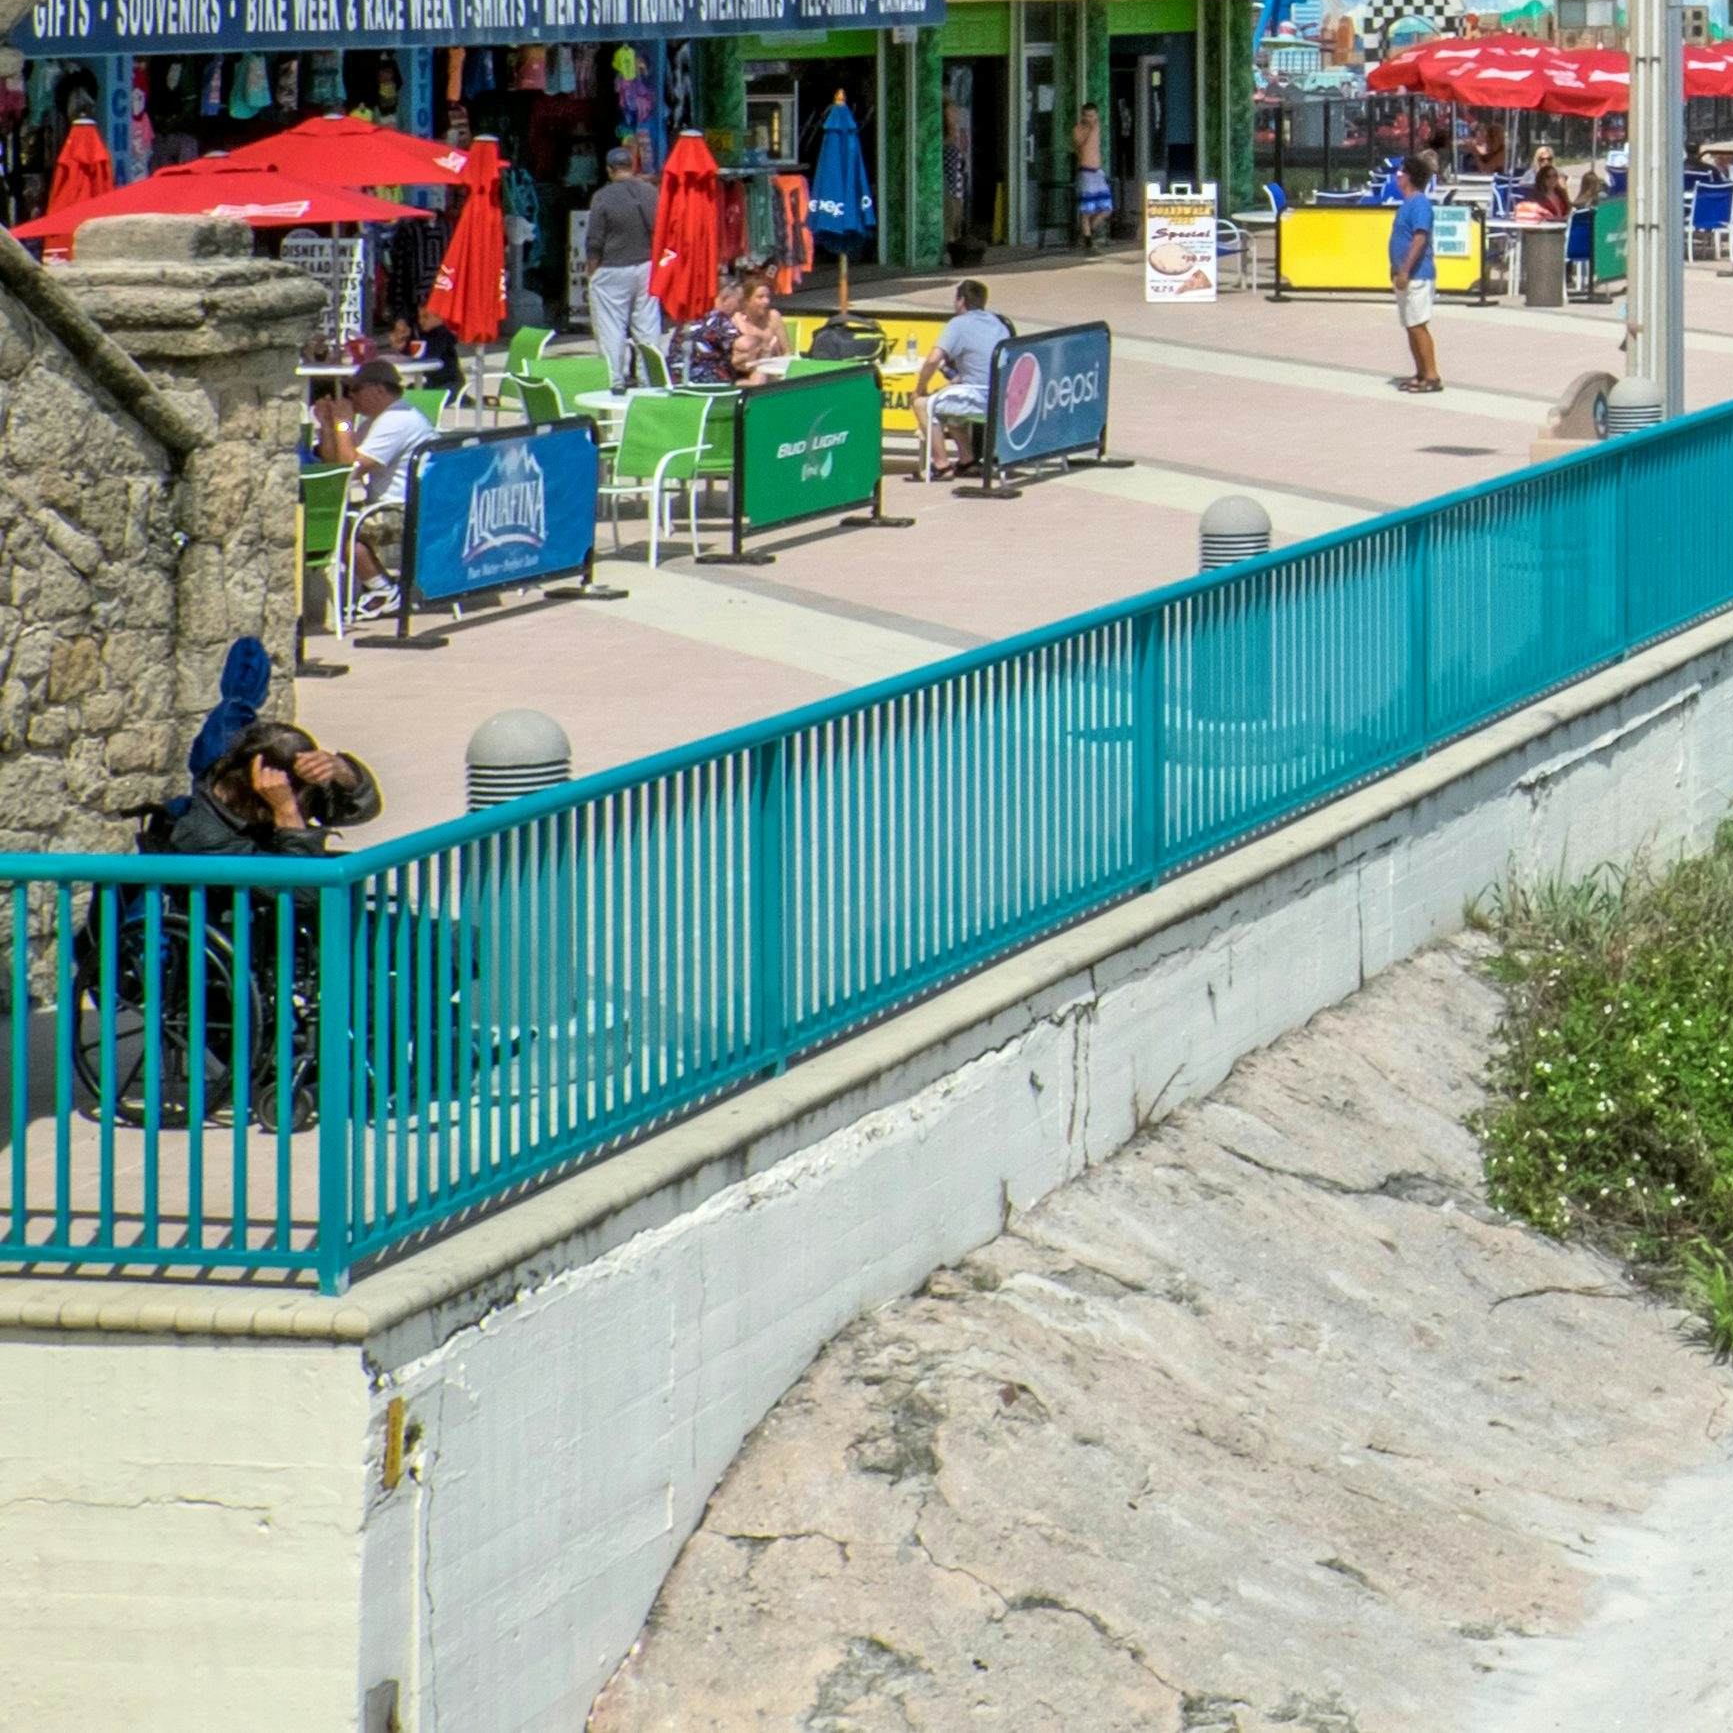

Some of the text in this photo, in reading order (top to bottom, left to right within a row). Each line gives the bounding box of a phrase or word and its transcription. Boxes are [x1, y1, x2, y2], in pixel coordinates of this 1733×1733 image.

[1151, 227, 1212, 241] Special
[1041, 361, 1101, 421] pepsi
[777, 430, 850, 459] BUD LIGHT
[463, 479, 547, 559] AQUAFINA
